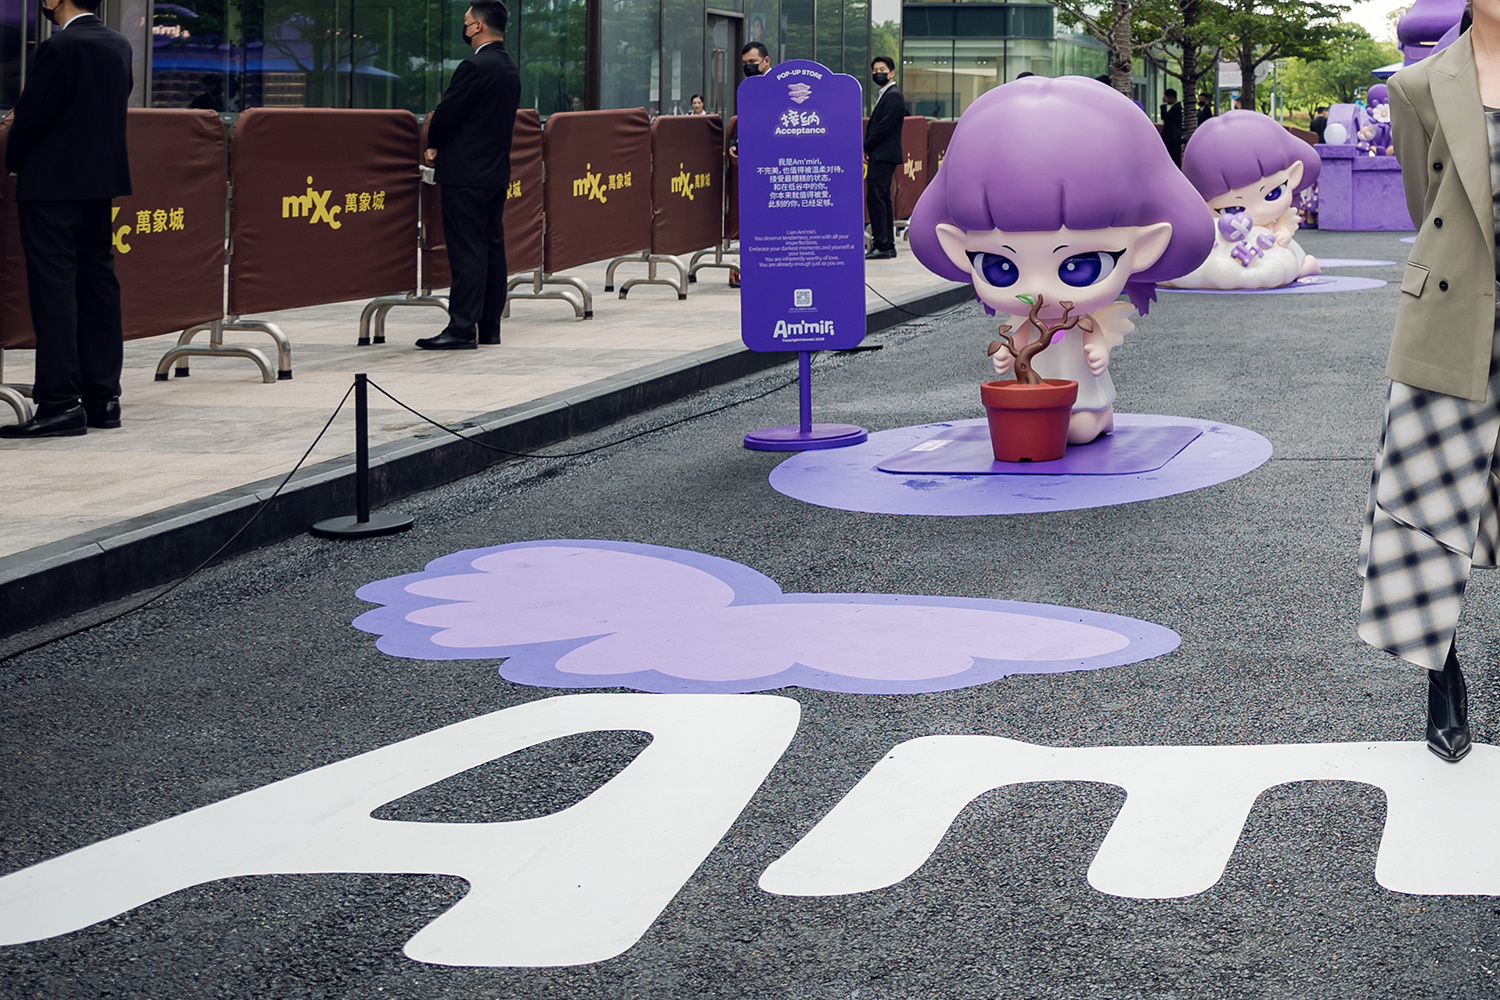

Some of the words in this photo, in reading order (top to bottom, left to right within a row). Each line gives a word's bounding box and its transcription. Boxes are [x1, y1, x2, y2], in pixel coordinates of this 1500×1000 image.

[776, 69, 801, 81] POP-UP
[801, 69, 823, 80] STORE
[780, 109, 820, 127] 接纳
[775, 126, 826, 136] Acceptance
[344, 190, 385, 214] 萬象城
[136, 207, 185, 234] 萬象城
[773, 319, 835, 339] Am'miri
